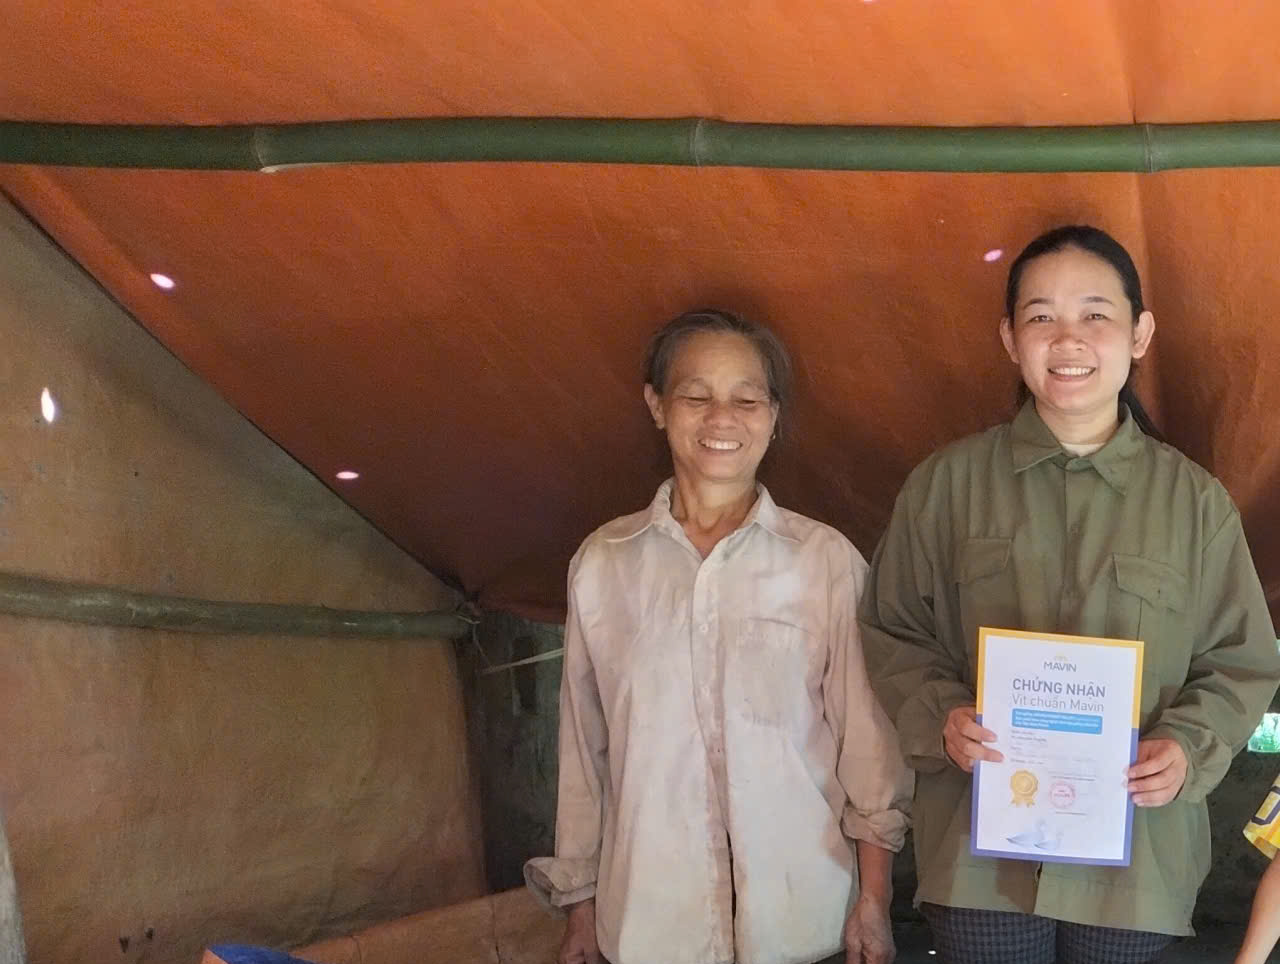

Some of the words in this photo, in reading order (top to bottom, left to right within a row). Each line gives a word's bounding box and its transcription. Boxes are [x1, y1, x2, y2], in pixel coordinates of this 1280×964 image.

[1043, 661, 1077, 672] MAVIN
[1012, 676, 1063, 694] CHỨNG
[1066, 681, 1106, 700] NHẬN
[1070, 699, 1105, 712] Mavin
